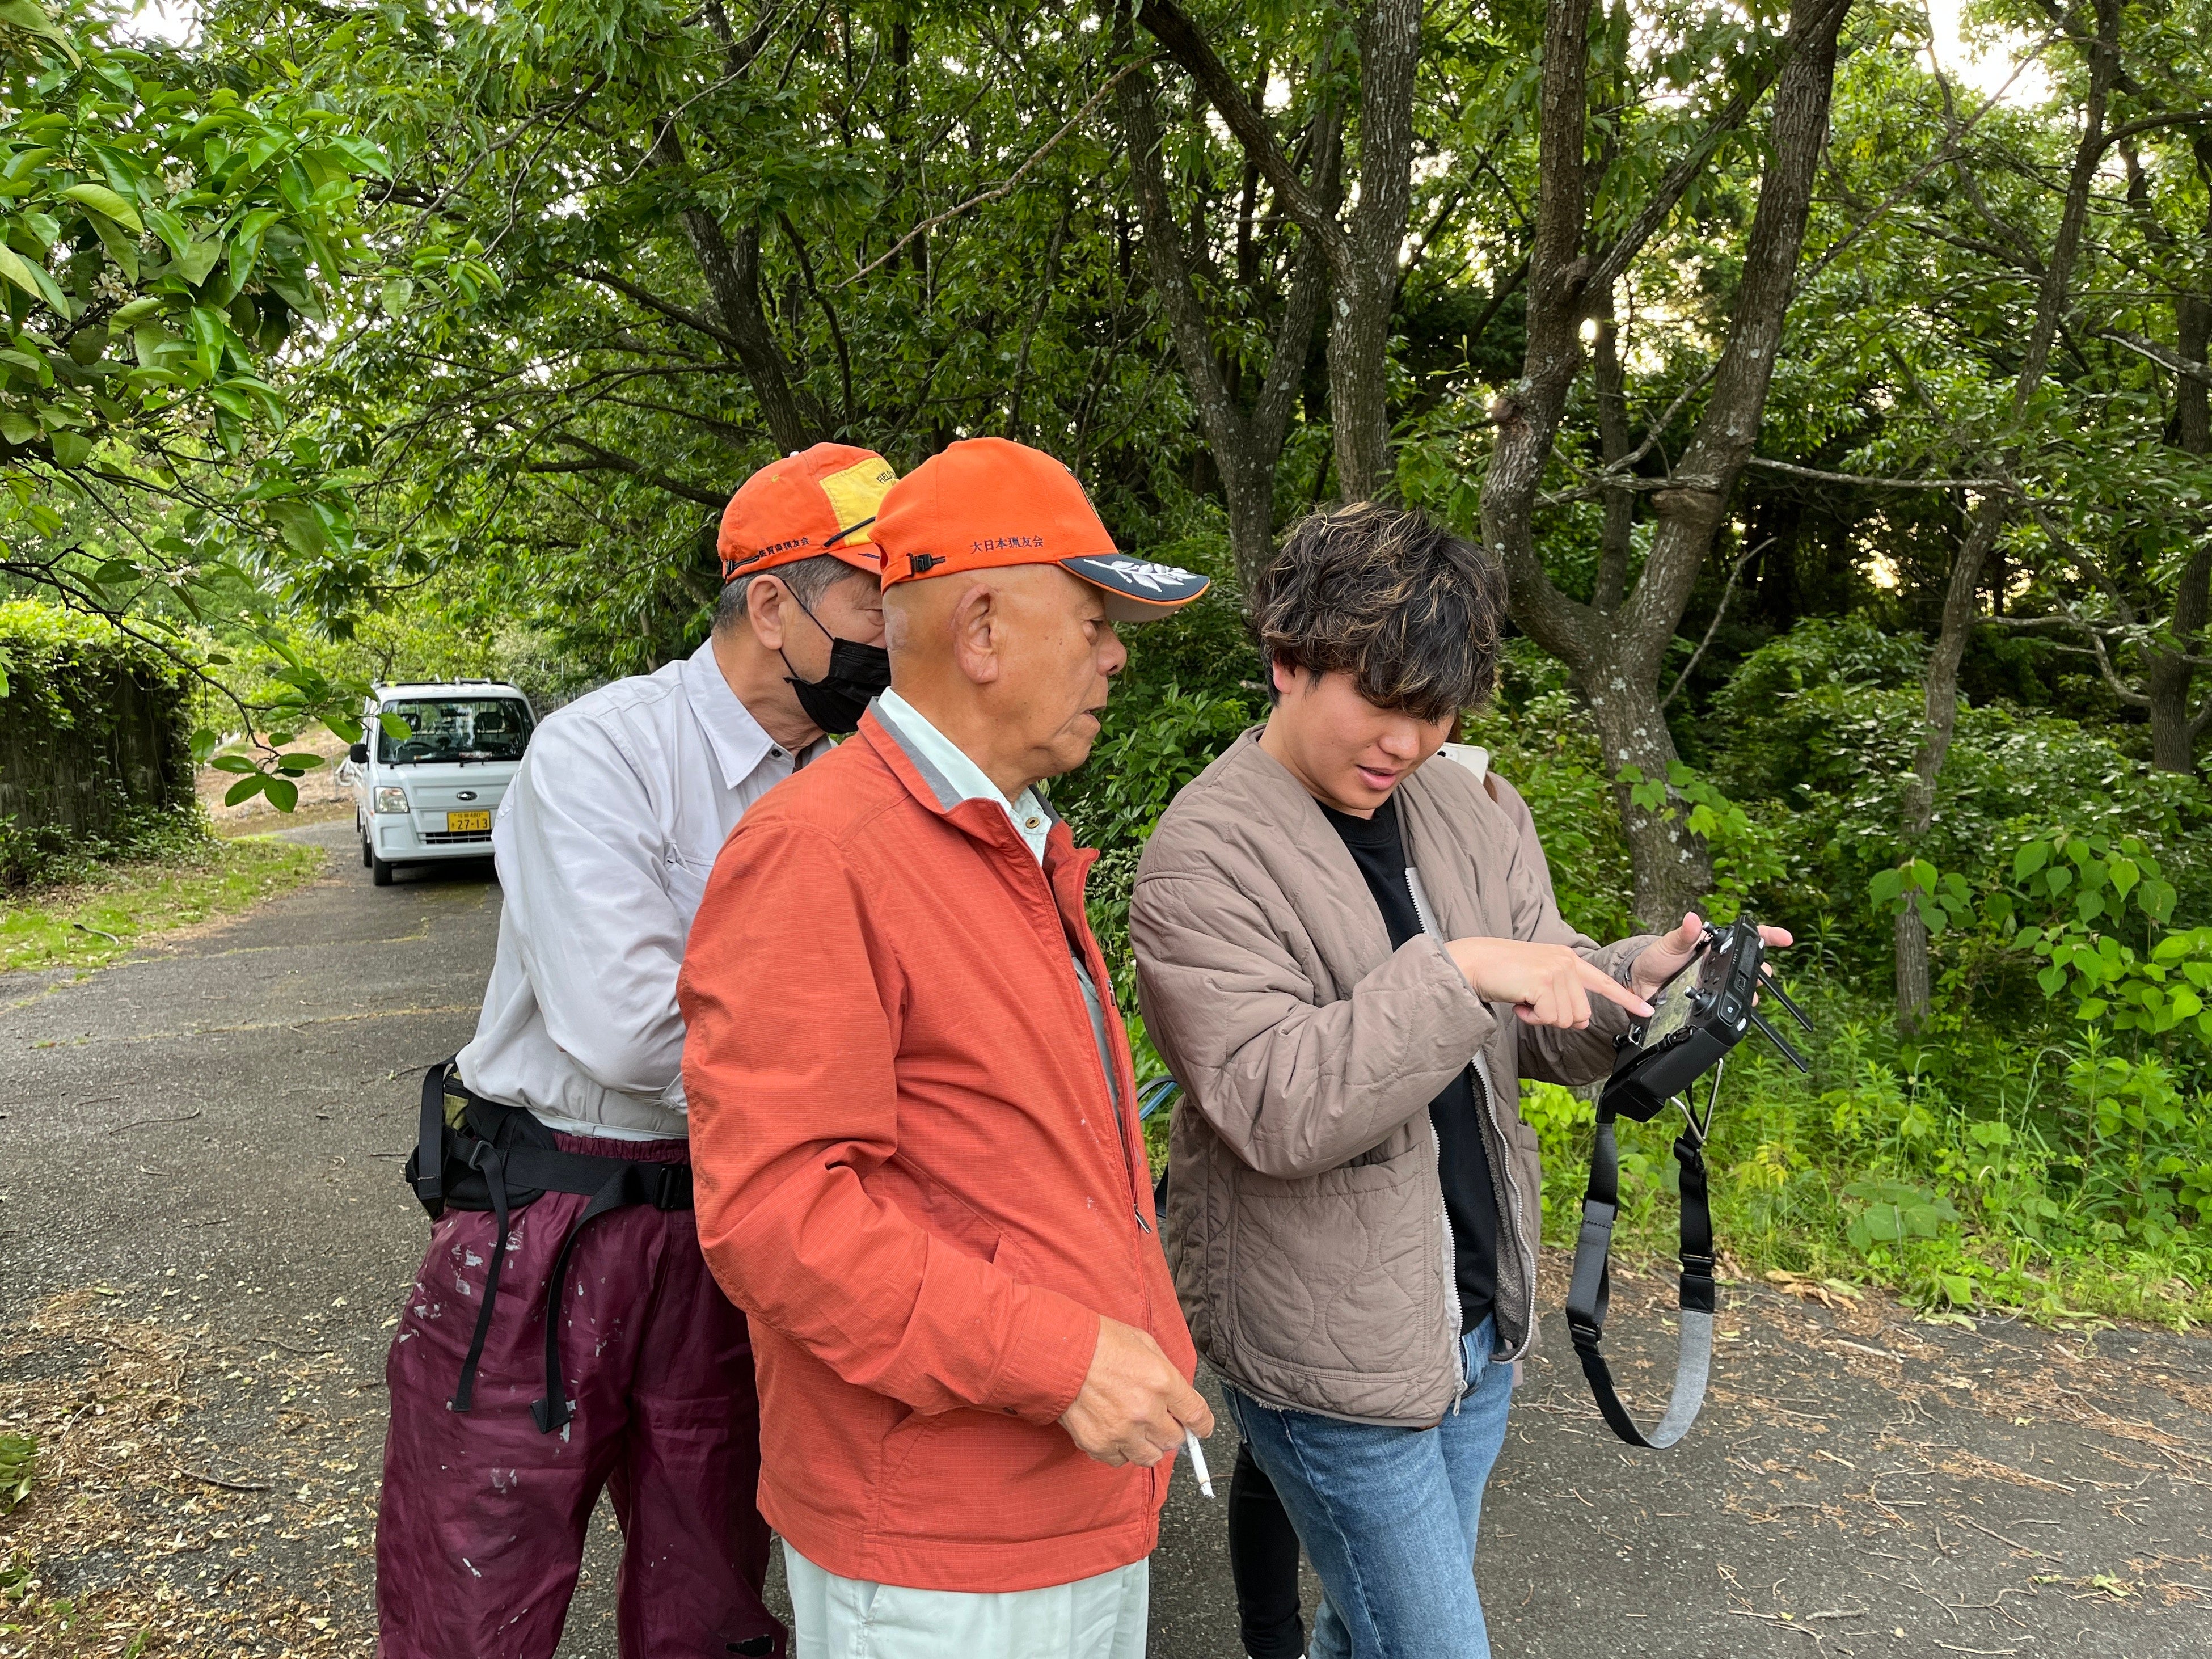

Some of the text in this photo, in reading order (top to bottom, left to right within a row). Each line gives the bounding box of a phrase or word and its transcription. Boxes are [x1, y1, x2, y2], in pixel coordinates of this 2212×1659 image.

[970, 535, 1044, 554] 大日本猟友会
